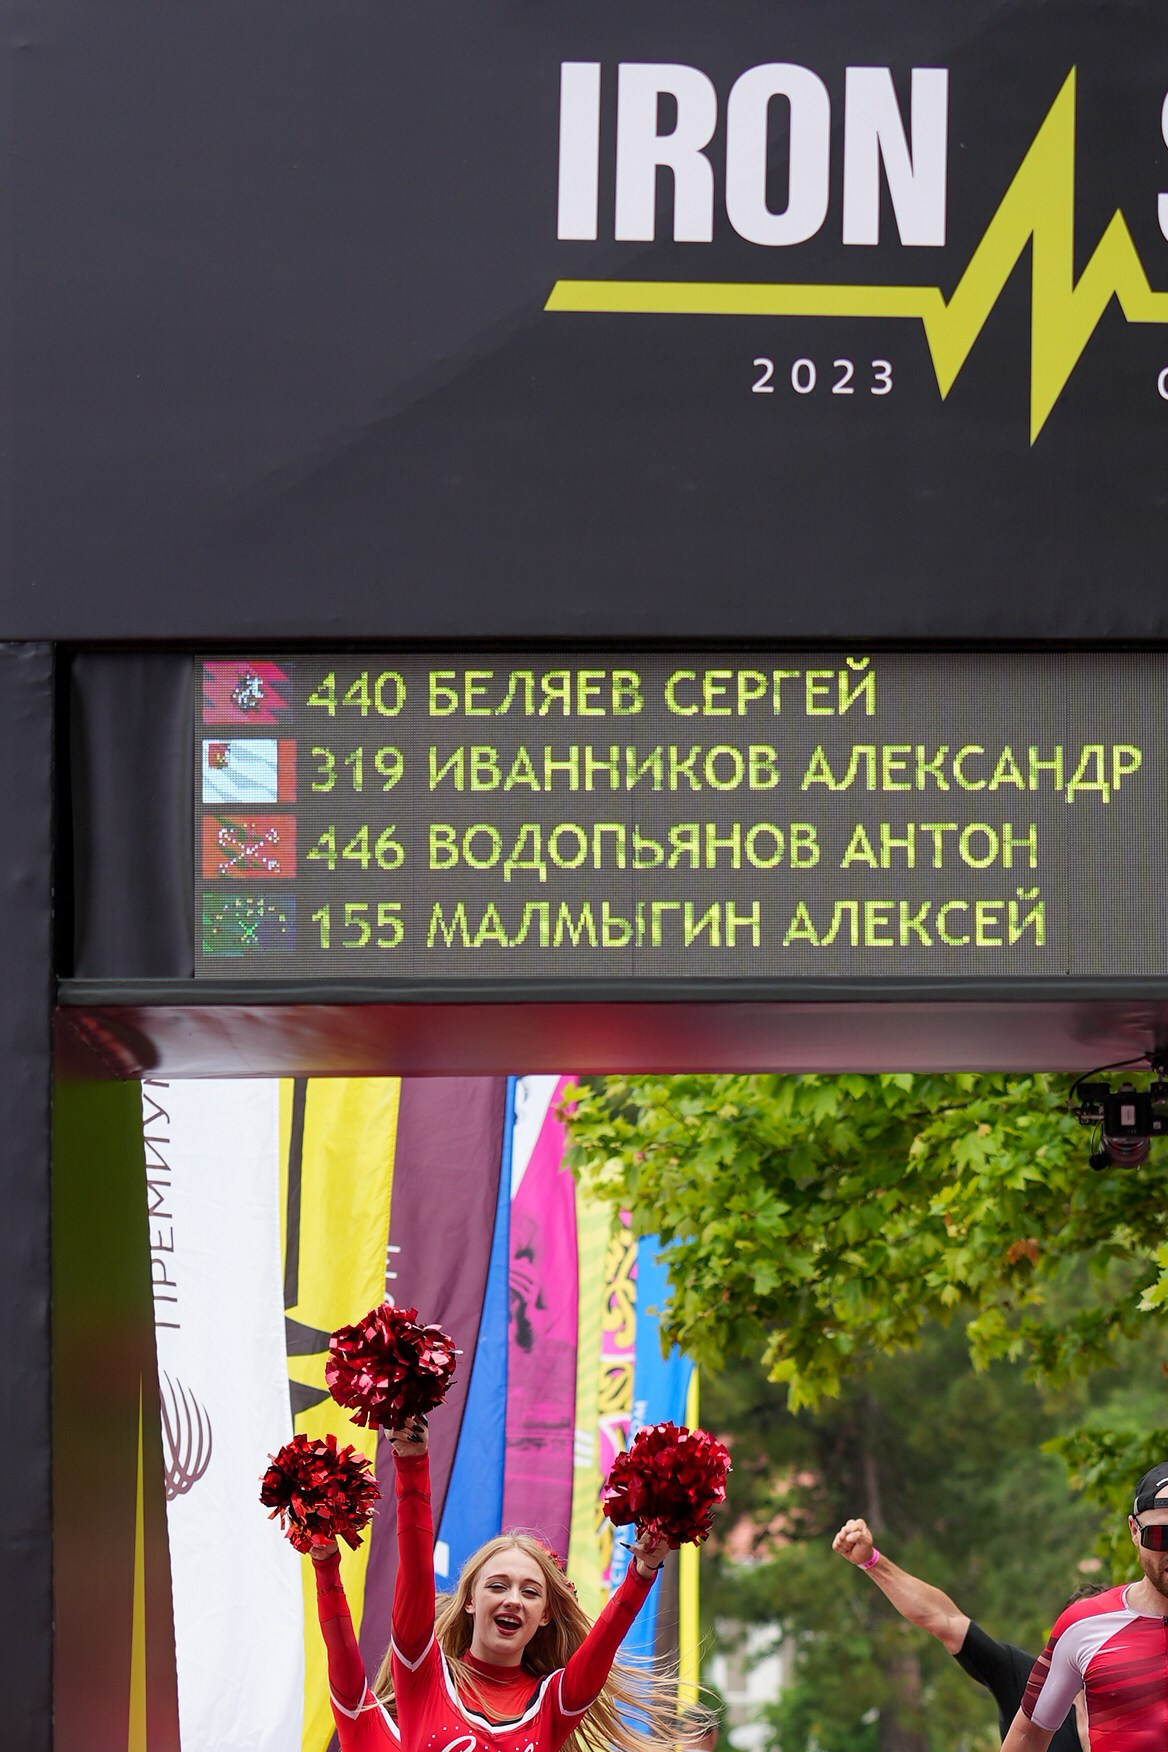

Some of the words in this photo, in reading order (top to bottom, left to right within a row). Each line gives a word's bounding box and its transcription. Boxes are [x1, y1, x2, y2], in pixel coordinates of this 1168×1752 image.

[556, 61, 949, 247] IRON
[751, 358, 895, 395] 2023
[308, 672, 406, 715] 440
[429, 671, 643, 715] БЕЛЯЕВ
[665, 657, 875, 715] СЕРГЕЙ
[311, 746, 405, 790] 319
[427, 745, 780, 791] ИВАННИКОВ
[800, 745, 1142, 803] АЛЕКСАНДР
[307, 824, 405, 869] 446
[428, 823, 821, 881] ВОДОПЬЯНОВ
[841, 823, 1038, 868] АНТОН
[310, 902, 404, 947] 155
[426, 900, 761, 947] МАЛМЫГИН
[783, 887, 1046, 946] АЛЕКСЕЙ
